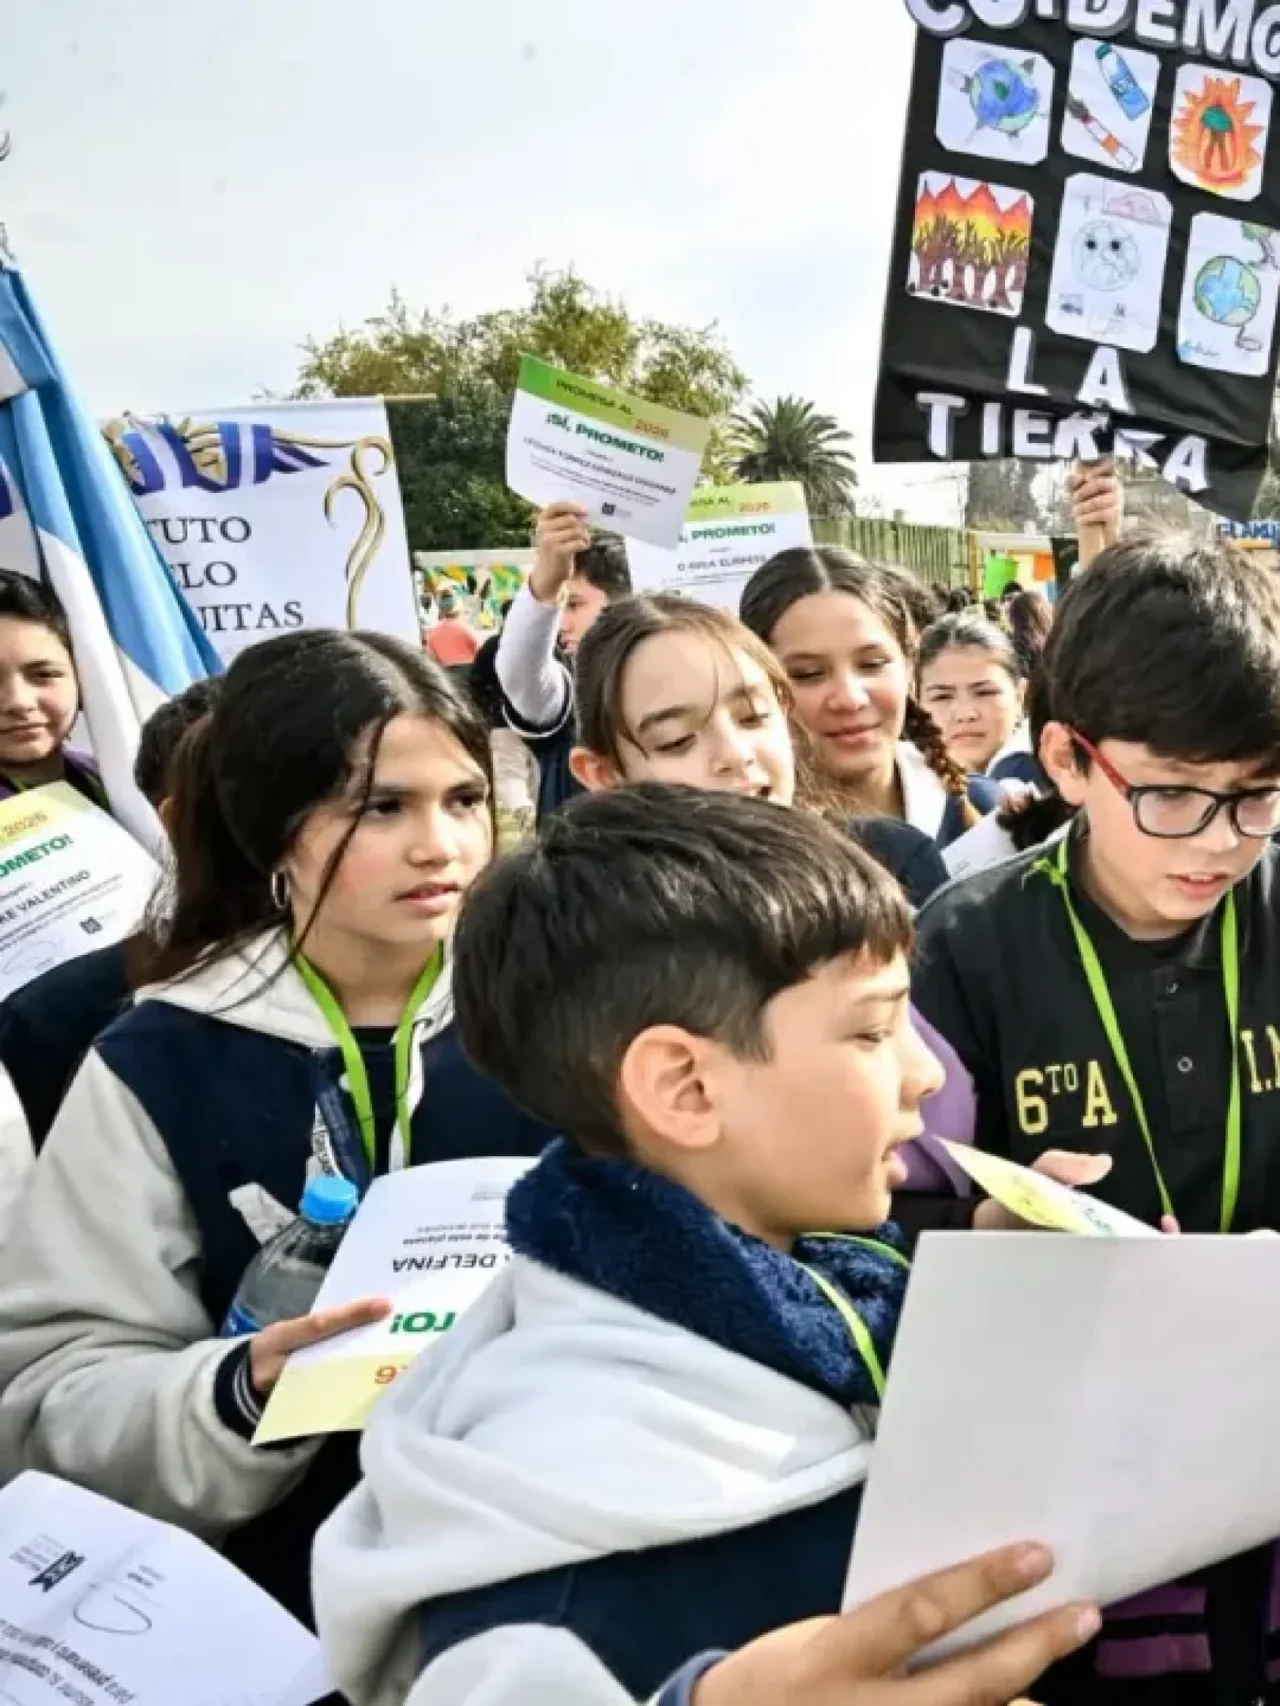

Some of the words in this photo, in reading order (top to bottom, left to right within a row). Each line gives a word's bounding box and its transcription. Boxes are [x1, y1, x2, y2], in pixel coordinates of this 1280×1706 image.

[1005, 326, 1136, 415] LA
[575, 423, 665, 463] PROMETO!
[691, 522, 776, 541] PROMETO!
[170, 560, 238, 589] LO
[16, 868, 92, 912] VALENTINO
[1081, 1060, 1118, 1128] A
[392, 1252, 497, 1273] DELFINA
